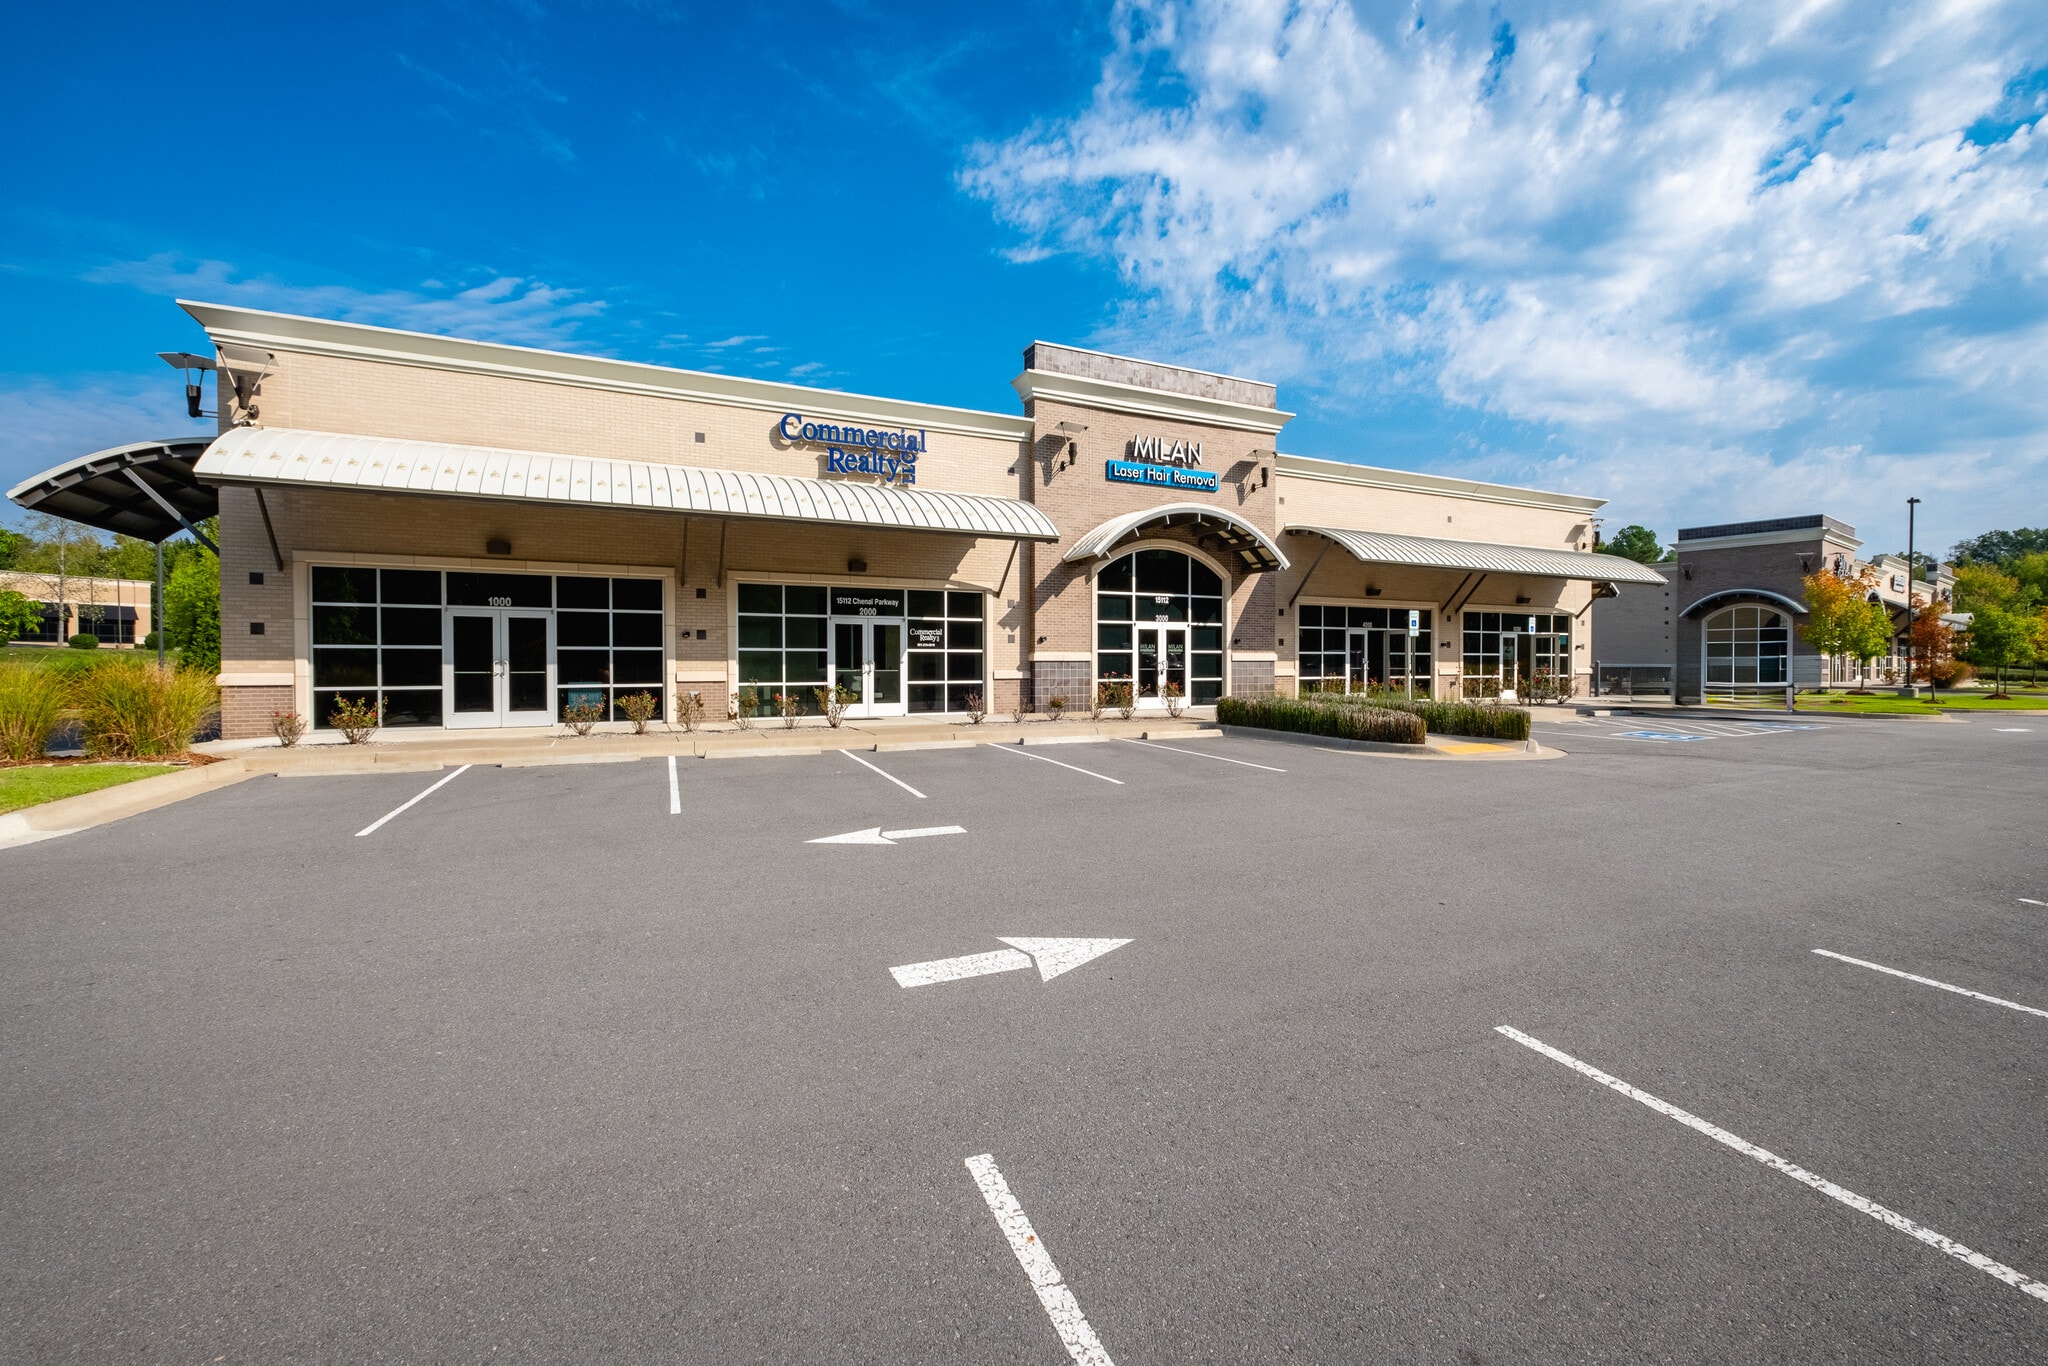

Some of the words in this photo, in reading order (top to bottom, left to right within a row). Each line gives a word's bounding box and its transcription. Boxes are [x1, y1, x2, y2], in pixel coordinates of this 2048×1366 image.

[780, 413, 927, 453] Commercial
[1133, 434, 1203, 465] MILAN
[826, 447, 900, 482] Realty
[901, 452, 916, 485] LLC
[1114, 462, 1144, 478] Laser
[1147, 467, 1171, 482] Hair
[1173, 470, 1218, 487] Removal
[488, 597, 512, 607] 1000
[836, 597, 852, 605] 15112
[852, 597, 874, 605] Chenal
[874, 598, 899, 608] Parkway
[1155, 596, 1169, 604] 15112
[859, 607, 877, 616] 2000
[909, 628, 943, 636] Commercial
[919, 634, 937, 642] Realty
